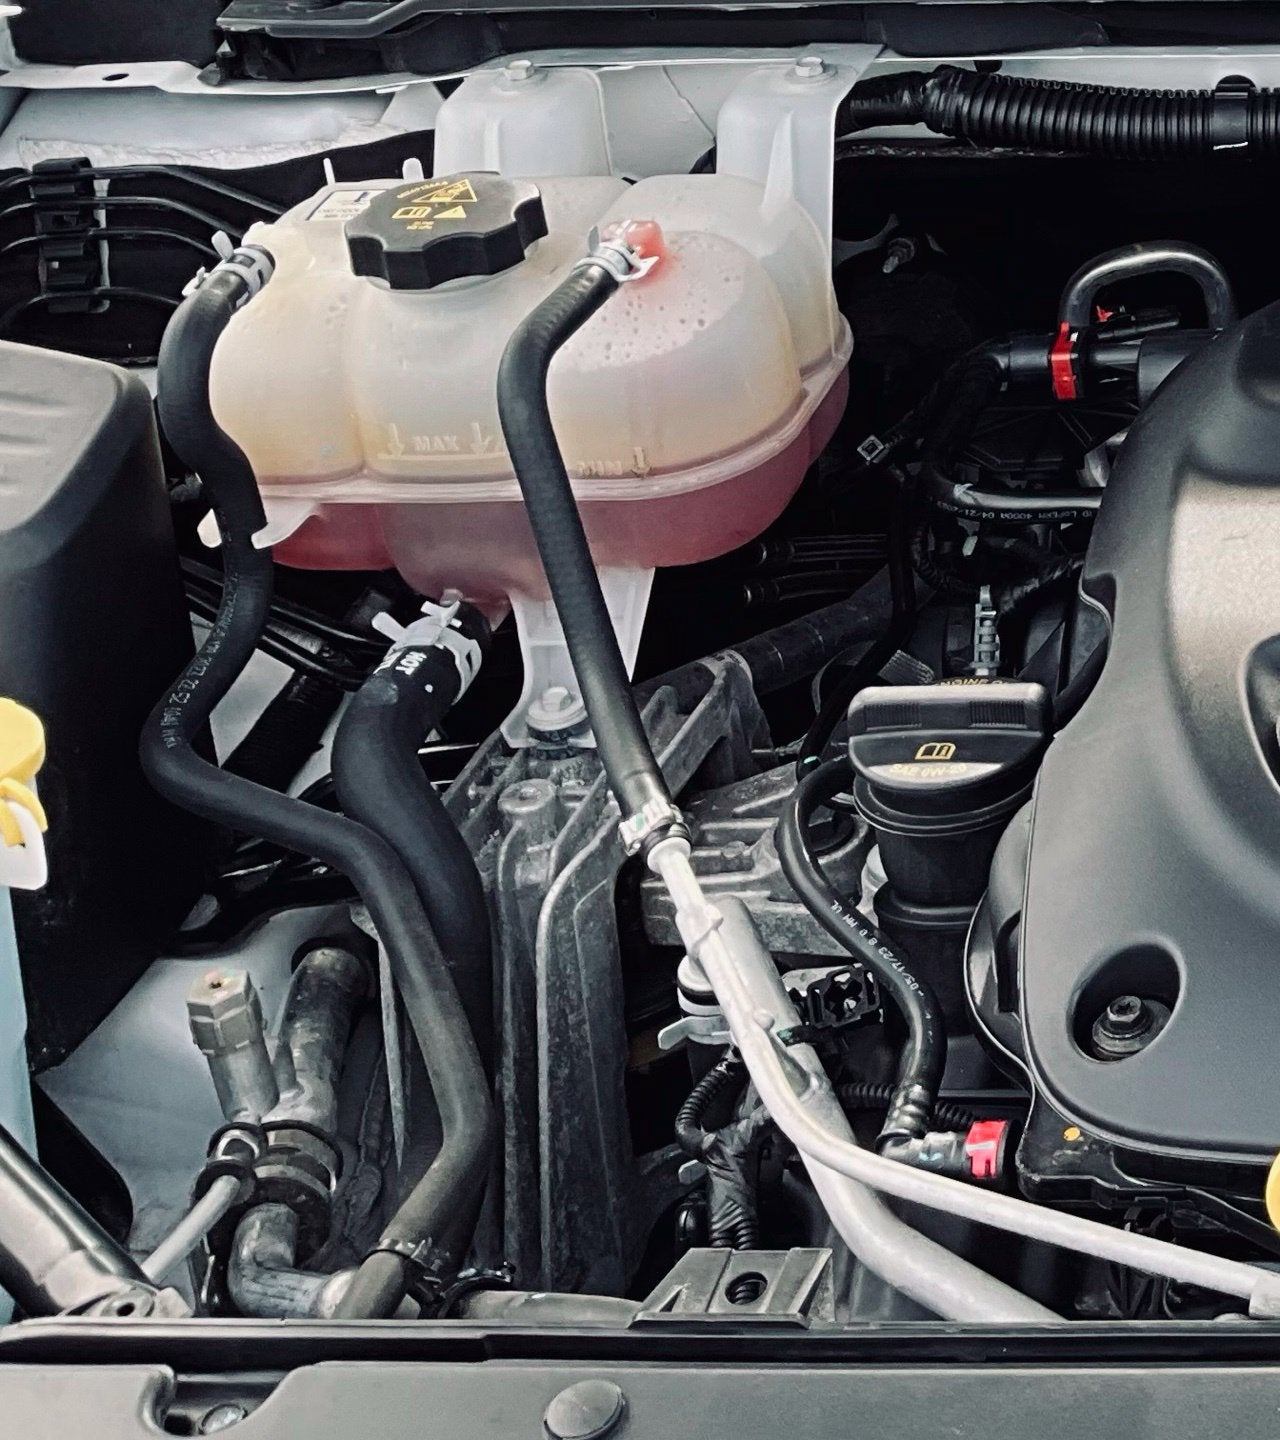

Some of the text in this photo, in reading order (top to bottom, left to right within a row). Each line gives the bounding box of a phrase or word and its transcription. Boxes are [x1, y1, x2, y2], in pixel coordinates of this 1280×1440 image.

[413, 434, 459, 452] MAX
[577, 460, 623, 476] MIN
[395, 651, 427, 675] HOT
[889, 763, 920, 776] SAE
